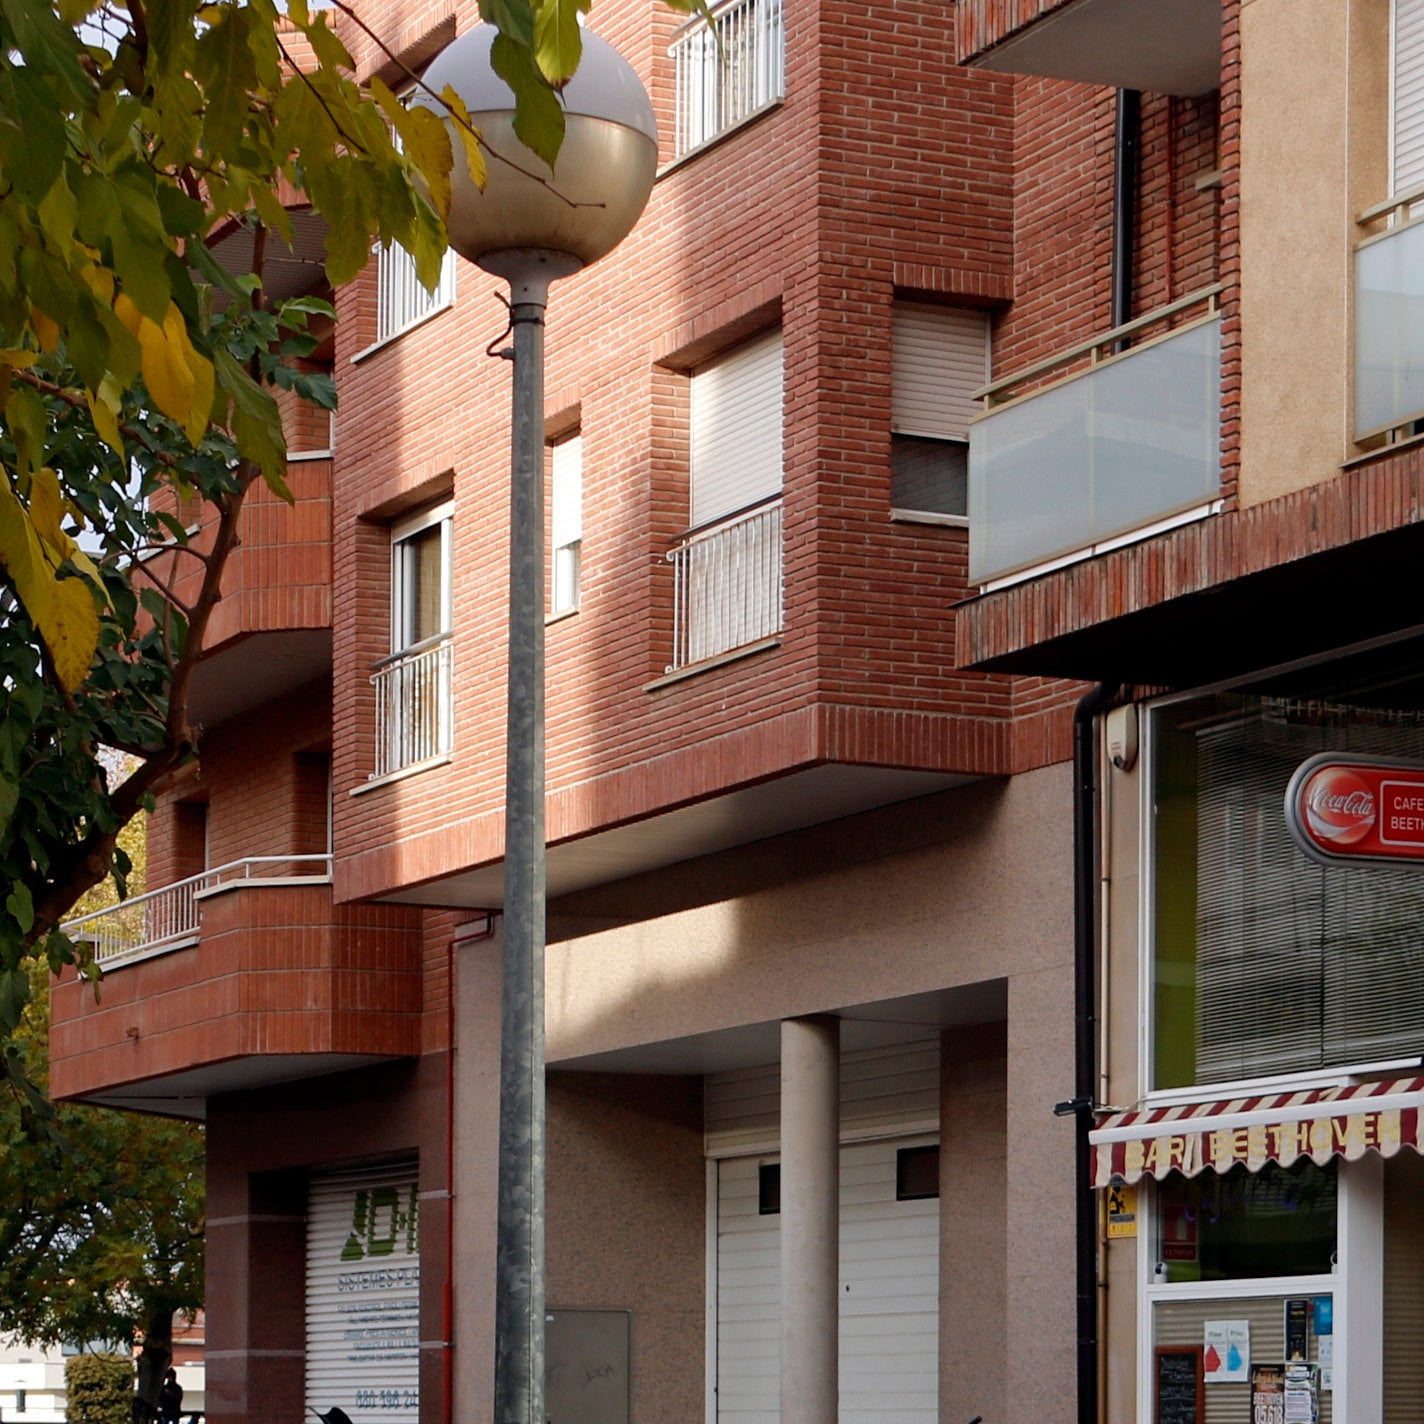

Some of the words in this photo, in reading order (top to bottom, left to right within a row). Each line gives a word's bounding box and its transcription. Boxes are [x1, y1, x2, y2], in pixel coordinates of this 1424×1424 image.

[1314, 787, 1375, 817] Coca-Cola
[1125, 1136, 1185, 1170] BAR
[1209, 1109, 1401, 1161] BEETHOVEN
